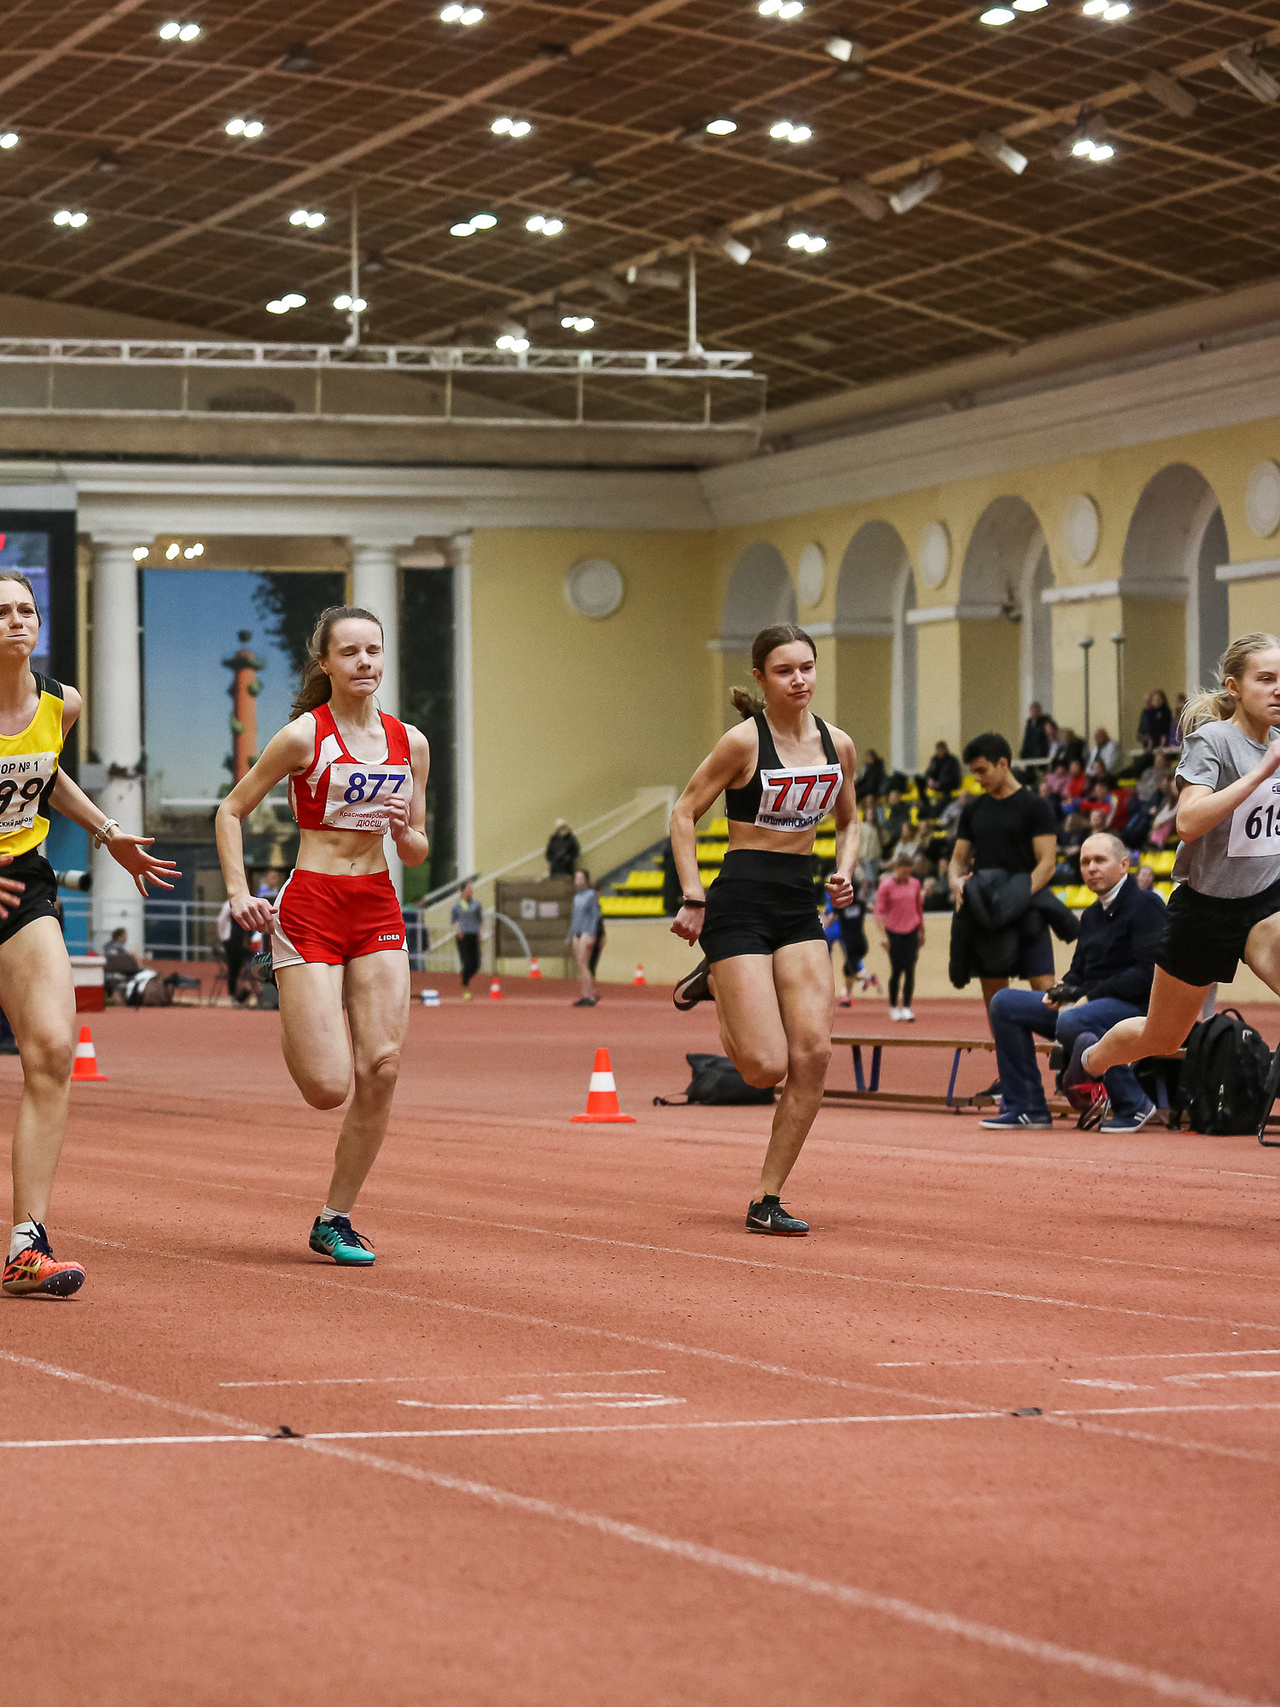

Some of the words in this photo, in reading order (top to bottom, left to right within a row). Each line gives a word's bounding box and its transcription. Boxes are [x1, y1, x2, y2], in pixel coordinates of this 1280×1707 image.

[19, 761, 31, 773] №
[33, 761, 39, 772] 1
[344, 772, 406, 804] 877
[768, 773, 839, 812] 777
[356, 819, 383, 829] ДЮСШ
[378, 934, 400, 942] LIDER
